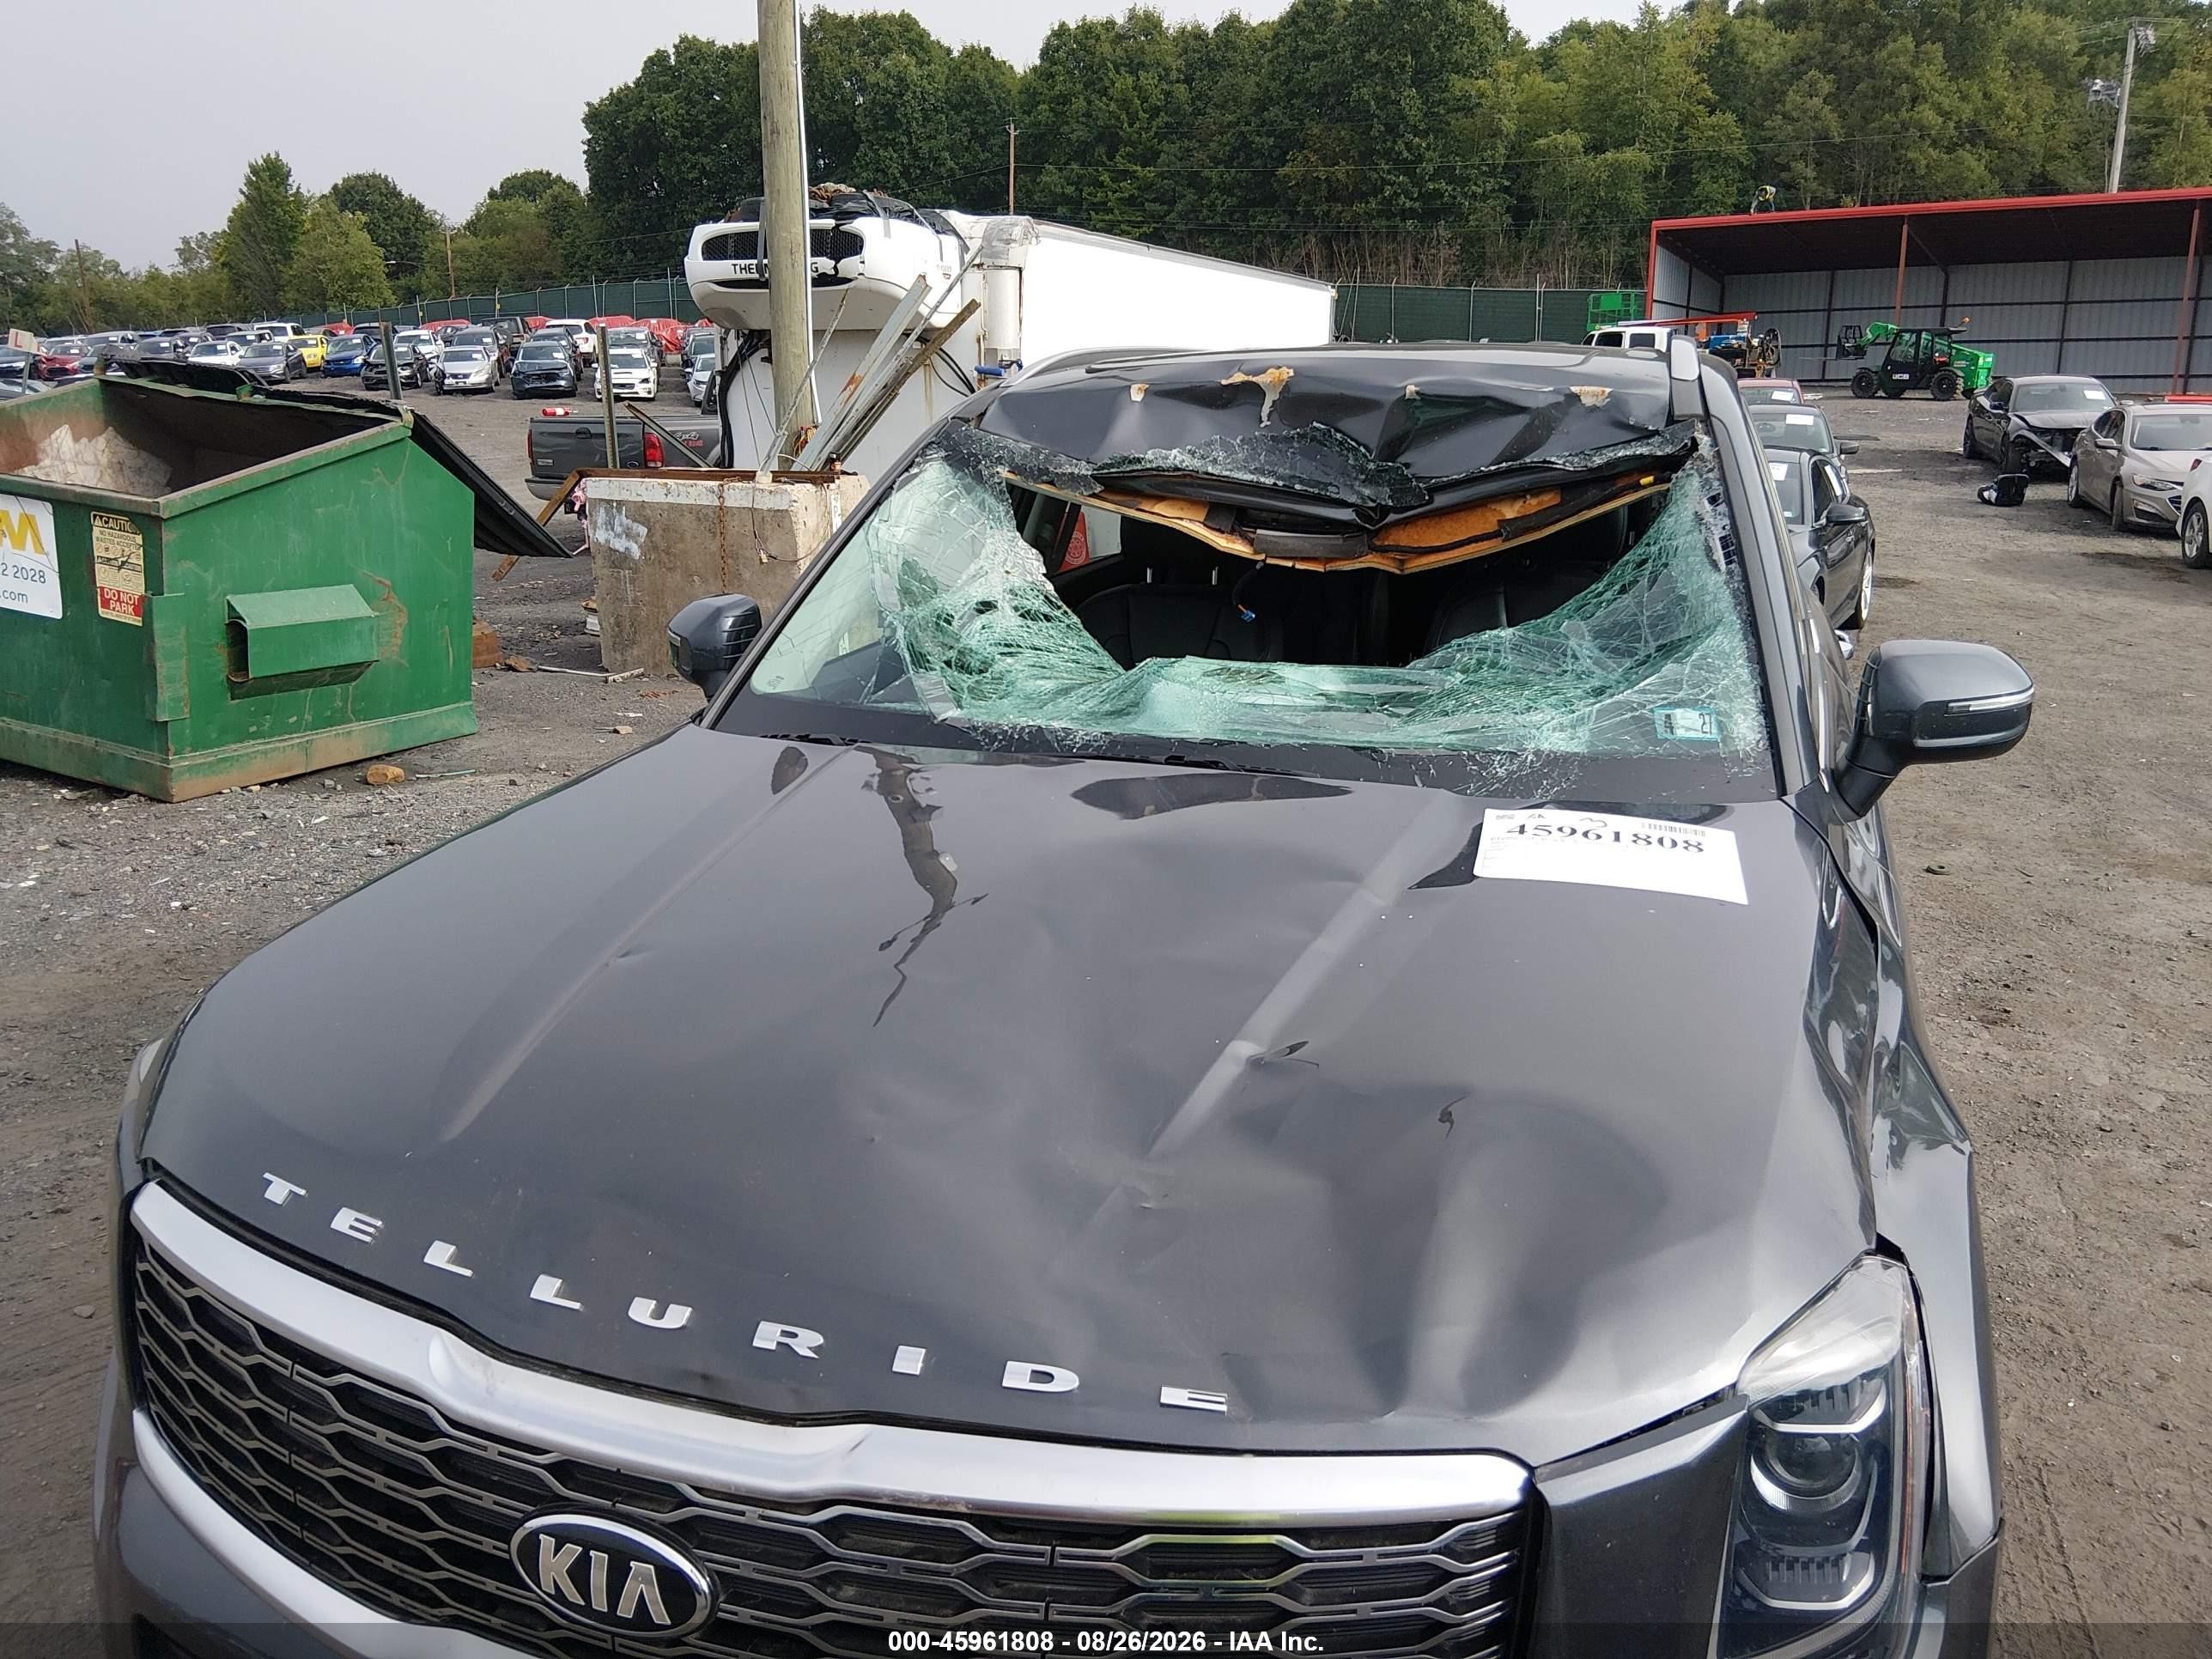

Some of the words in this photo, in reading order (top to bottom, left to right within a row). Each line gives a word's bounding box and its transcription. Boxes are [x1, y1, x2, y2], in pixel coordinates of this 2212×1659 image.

[12, 563, 46, 585] 2028
[103, 587, 118, 600] DO
[119, 591, 140, 606] NOT
[109, 599, 135, 616] PARK
[1506, 823, 1705, 854] 45961808
[263, 1171, 1229, 1416] TELLURIDE
[538, 1533, 672, 1626] KIA
